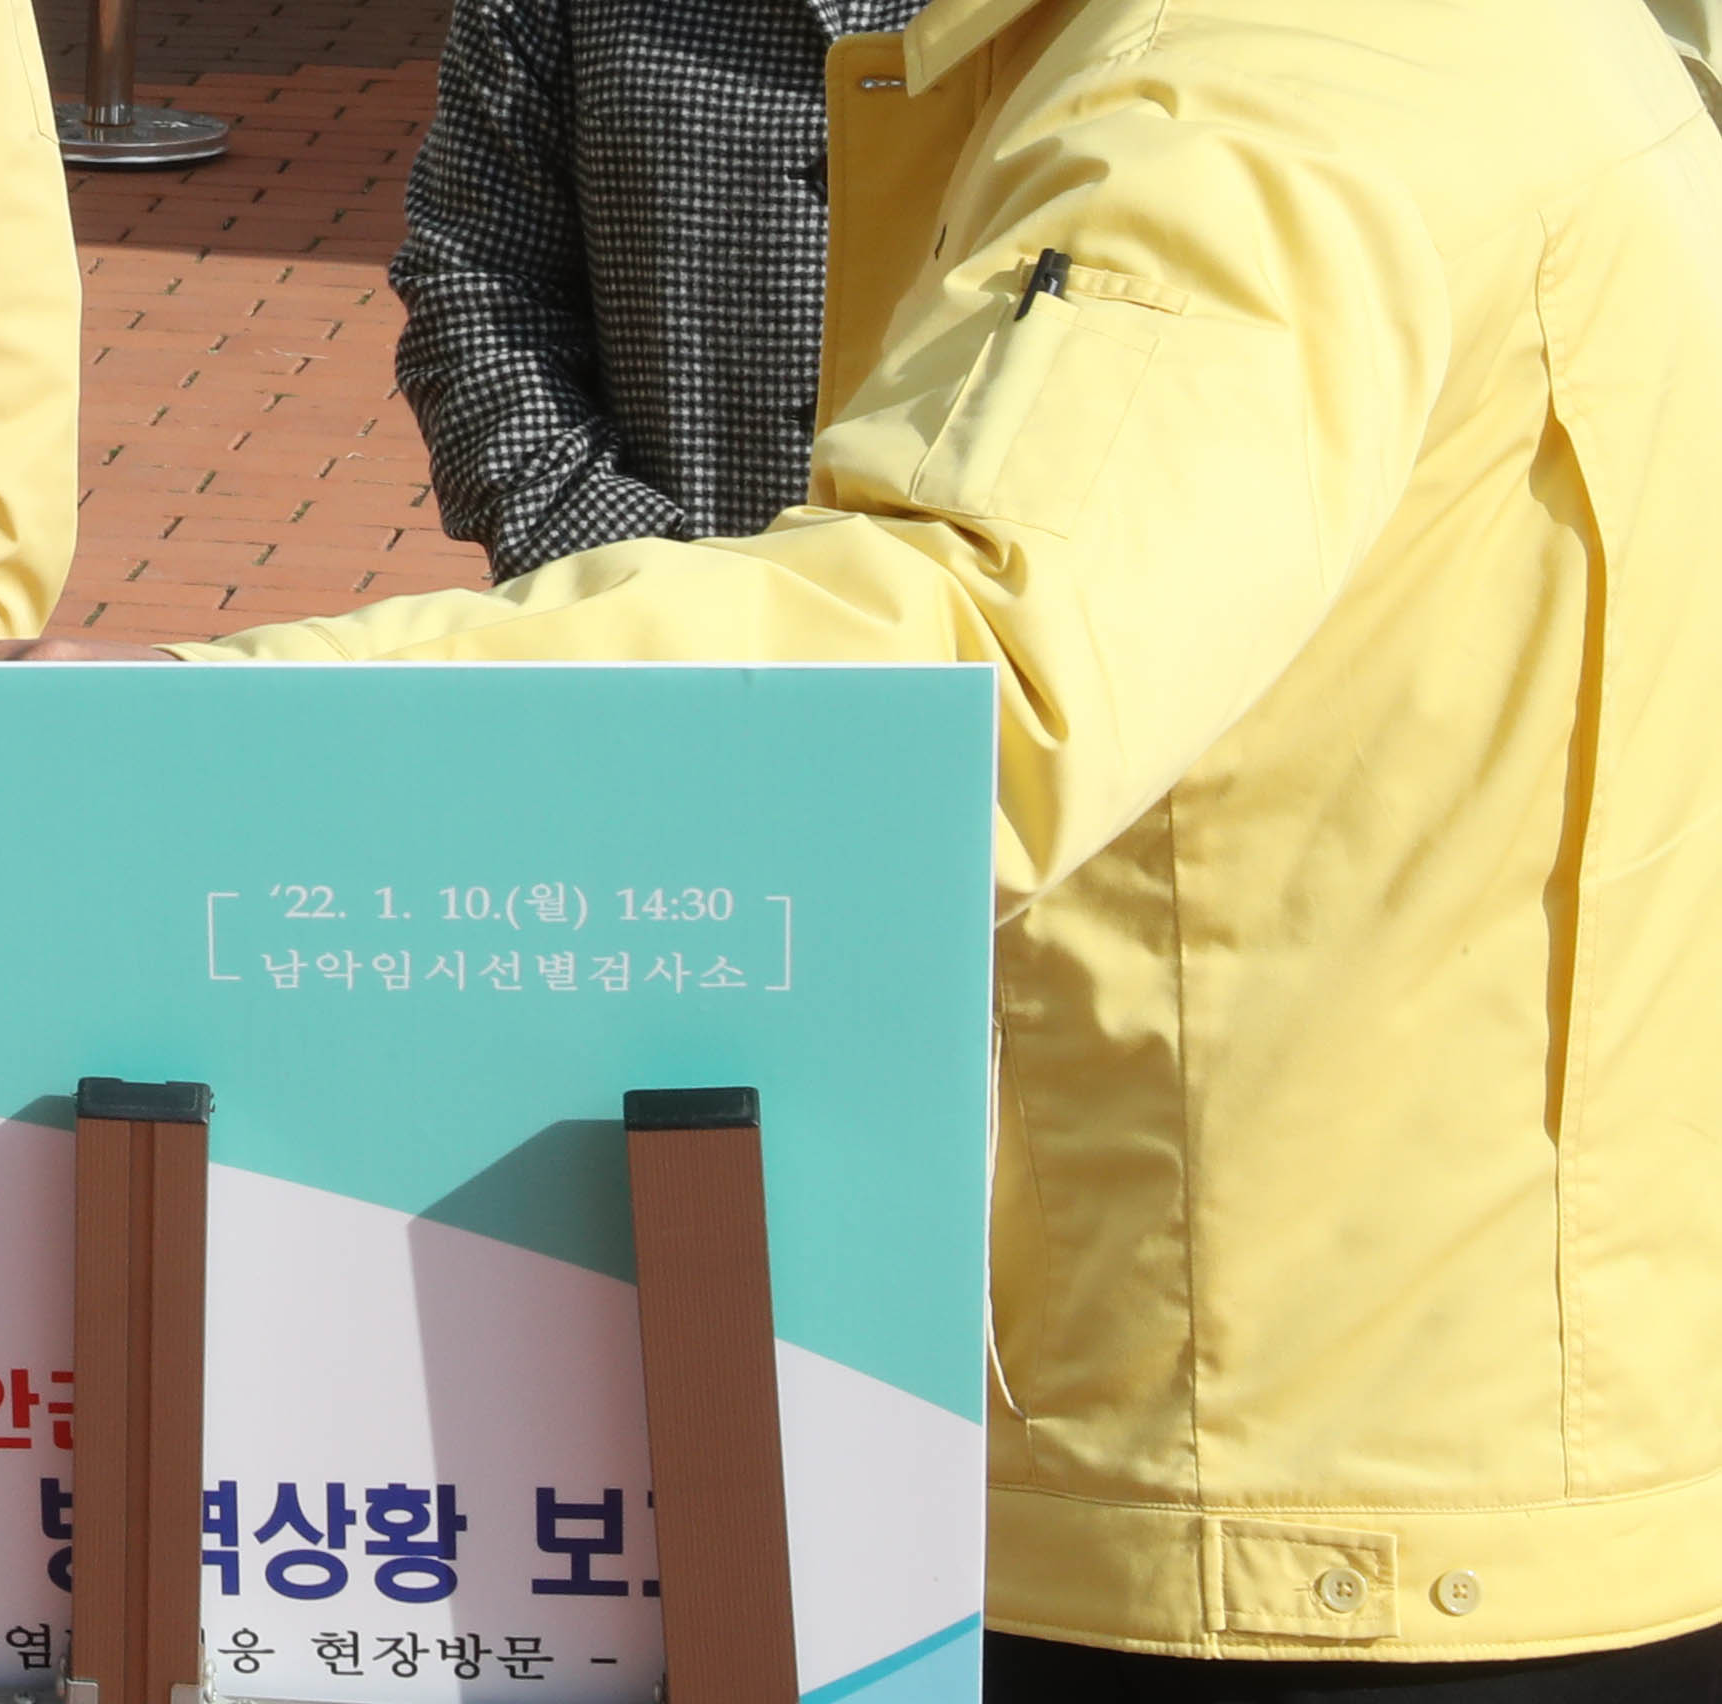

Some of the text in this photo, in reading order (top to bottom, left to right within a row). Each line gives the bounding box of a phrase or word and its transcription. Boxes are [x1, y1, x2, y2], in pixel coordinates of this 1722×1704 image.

[374, 886, 411, 919] 1.
[439, 882, 590, 930] 10.(월)
[617, 887, 735, 921] 14:30
[262, 948, 747, 993] 남악임시선별검사소
[531, 1487, 659, 1596] 보
[310, 1630, 554, 1681] 현장방문
